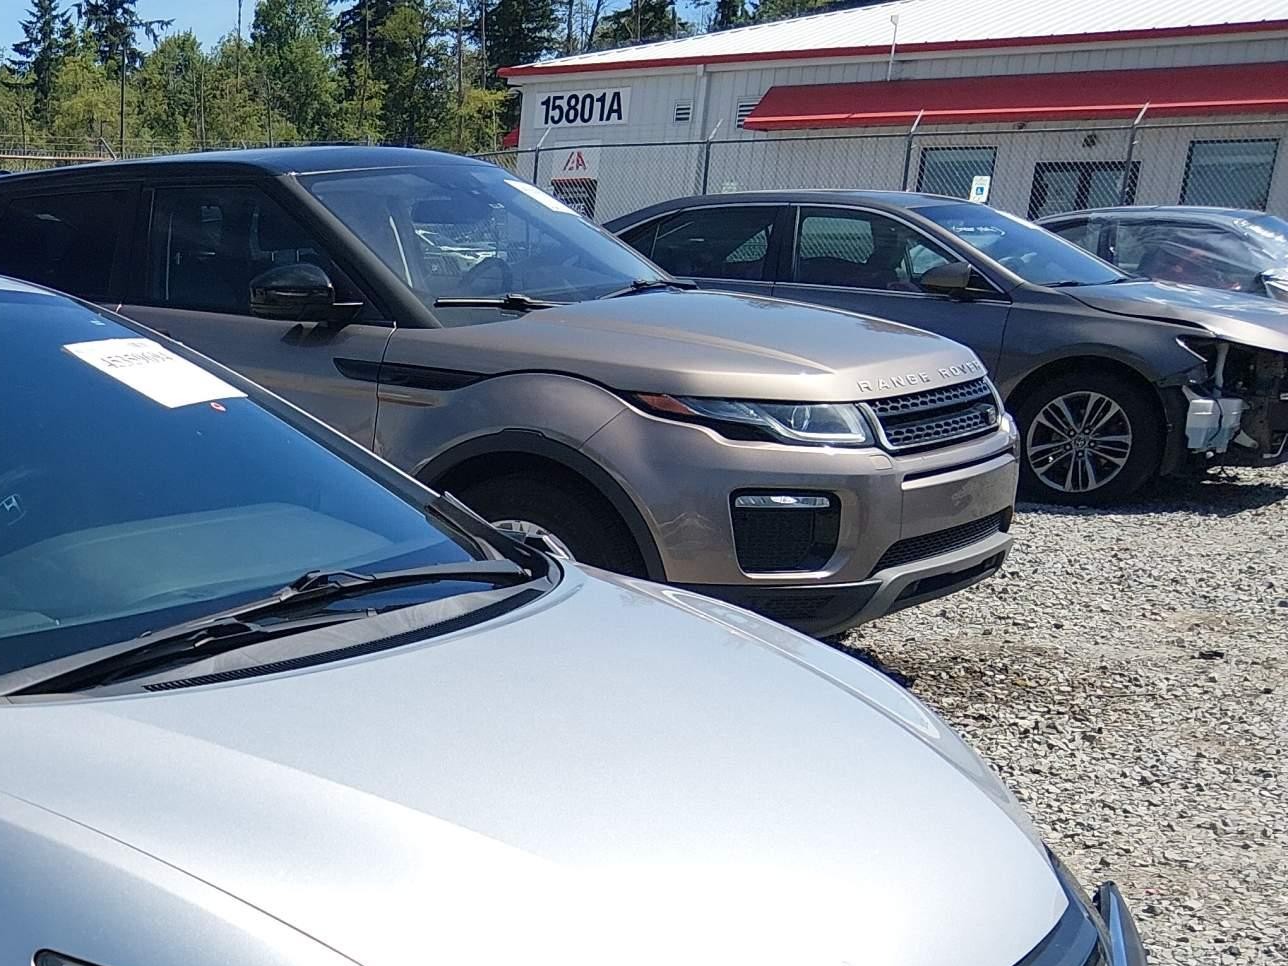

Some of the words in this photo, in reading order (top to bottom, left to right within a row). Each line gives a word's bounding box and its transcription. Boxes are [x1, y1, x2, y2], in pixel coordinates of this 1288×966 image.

[541, 91, 623, 125] 15801A
[857, 373, 931, 393] RANGE
[938, 360, 983, 379] ROVER
